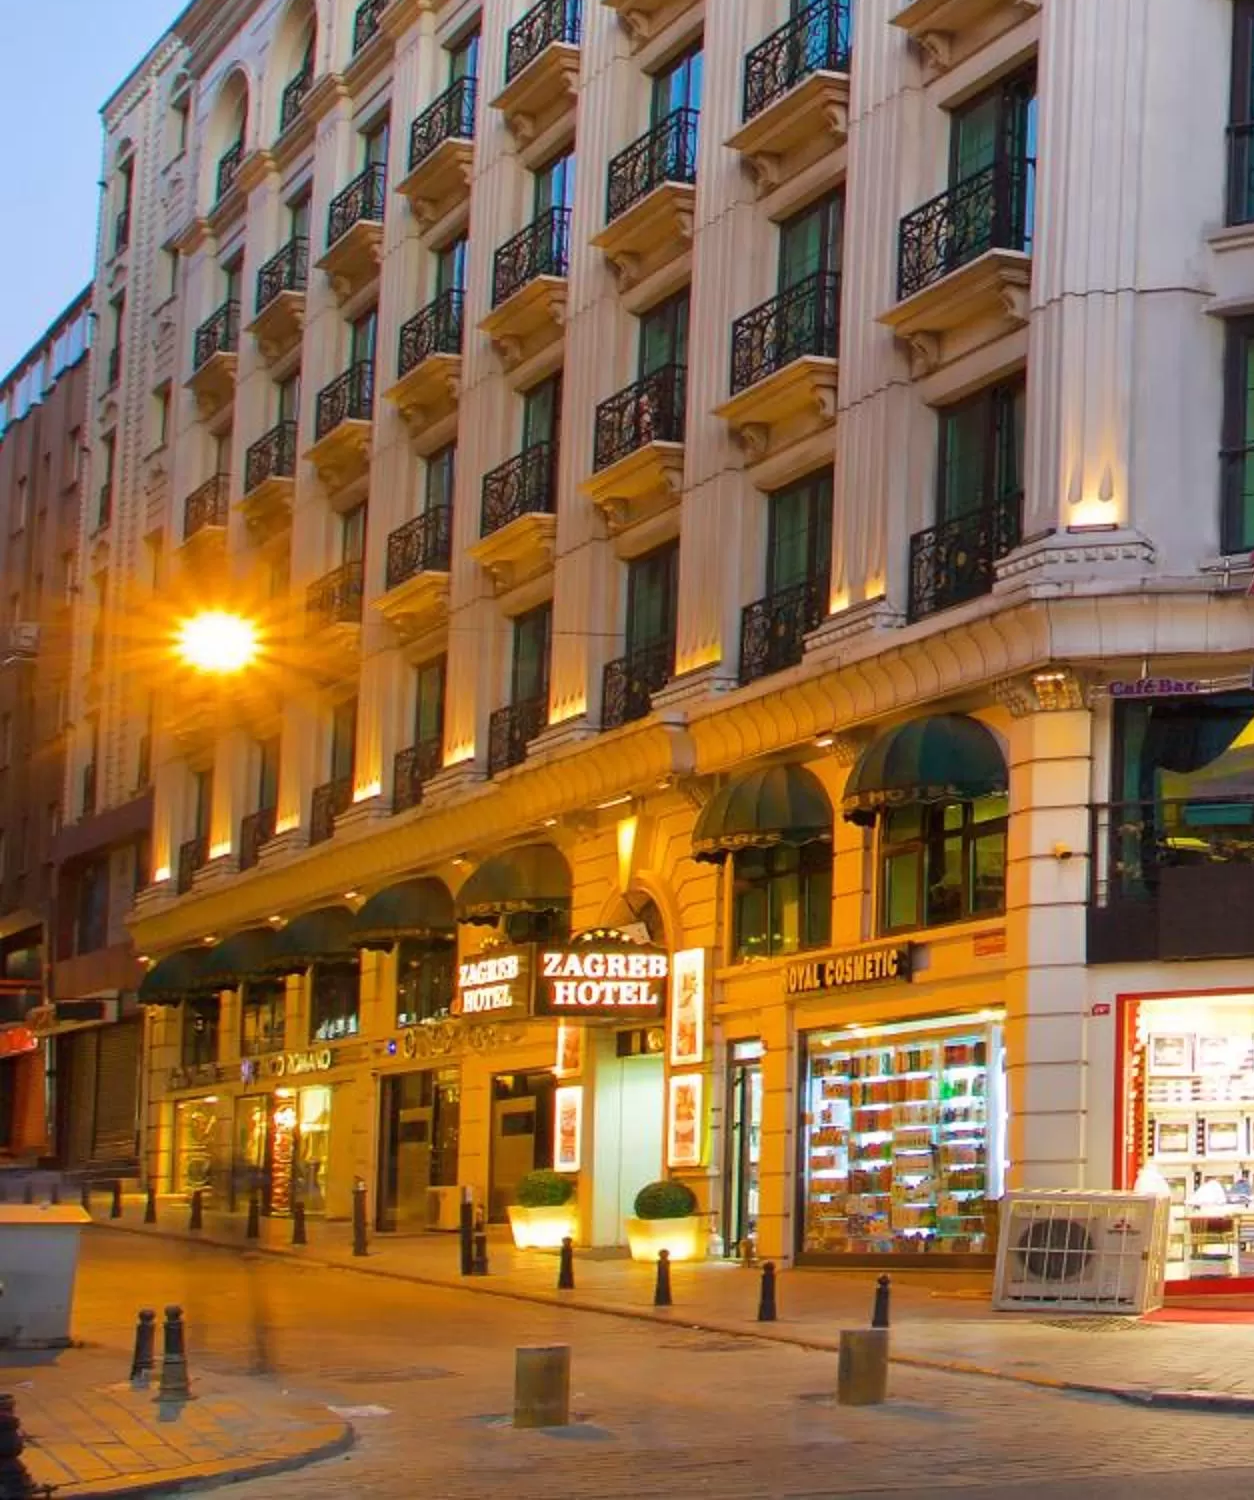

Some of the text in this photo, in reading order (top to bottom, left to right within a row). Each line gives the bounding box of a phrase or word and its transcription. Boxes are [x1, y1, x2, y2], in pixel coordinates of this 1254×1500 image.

[1109, 676, 1155, 697] Café
[459, 955, 519, 988] ZAGREB
[543, 953, 668, 978] ZAGREB
[825, 949, 899, 986] COSMETIC
[463, 984, 513, 1014] HOTEL
[553, 981, 658, 1005] HOTEL
